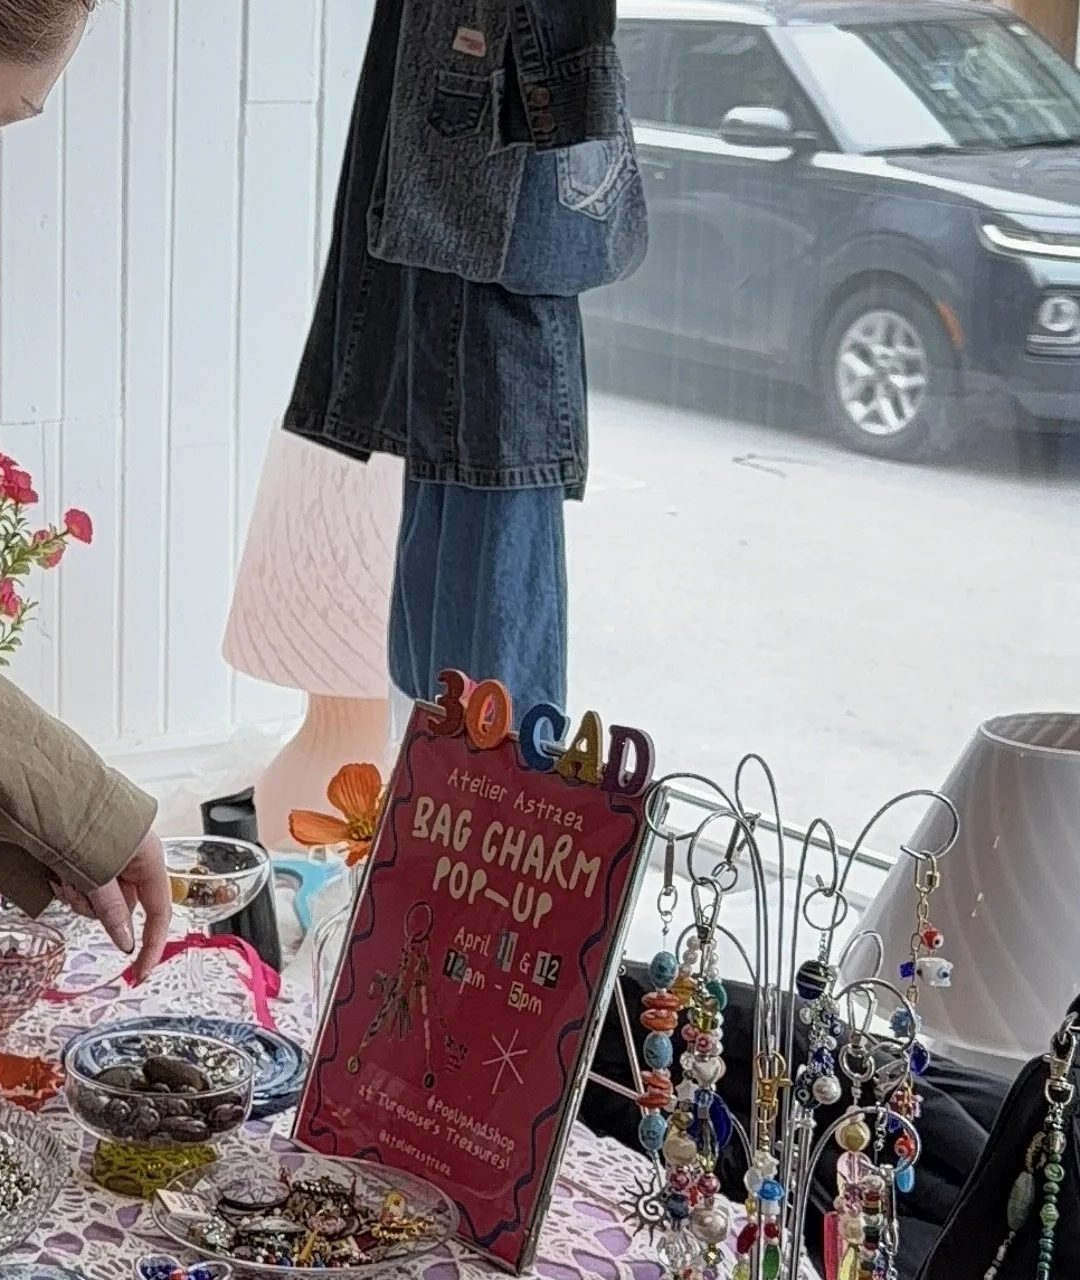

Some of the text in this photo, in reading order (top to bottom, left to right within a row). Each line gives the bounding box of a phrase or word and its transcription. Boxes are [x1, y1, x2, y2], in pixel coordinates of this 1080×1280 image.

[427, 669, 656, 798] 30 CAD
[447, 768, 584, 832] Atelier Astraea
[412, 796, 601, 898] BAG CHARM
[432, 856, 553, 929] POP-UP
[454, 926, 492, 957] April
[520, 952, 532, 975] &
[535, 952, 561, 985] 12
[508, 982, 542, 1015] 5pm
[377, 1091, 440, 1136] Turquoise's
[446, 1126, 511, 1170] Treasures!
